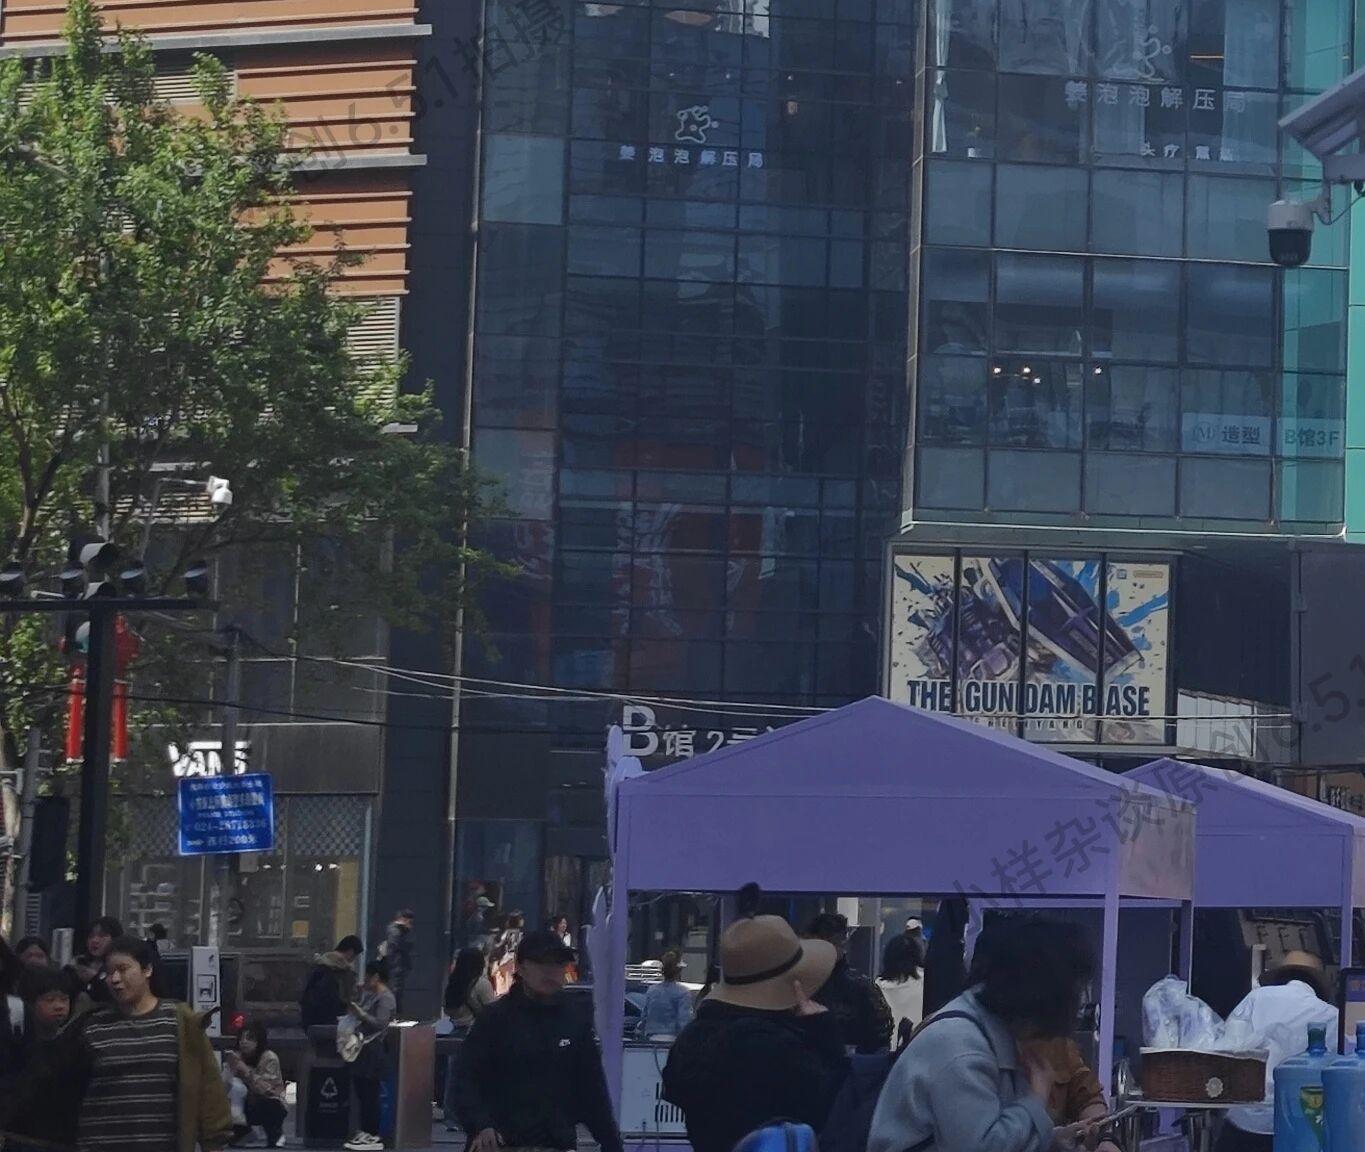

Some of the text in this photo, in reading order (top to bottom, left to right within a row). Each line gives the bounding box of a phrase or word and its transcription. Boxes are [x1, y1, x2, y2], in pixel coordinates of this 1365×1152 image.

[1221, 425, 1261, 445] 造型
[907, 679, 1151, 716] THE GUNDAM BASE
